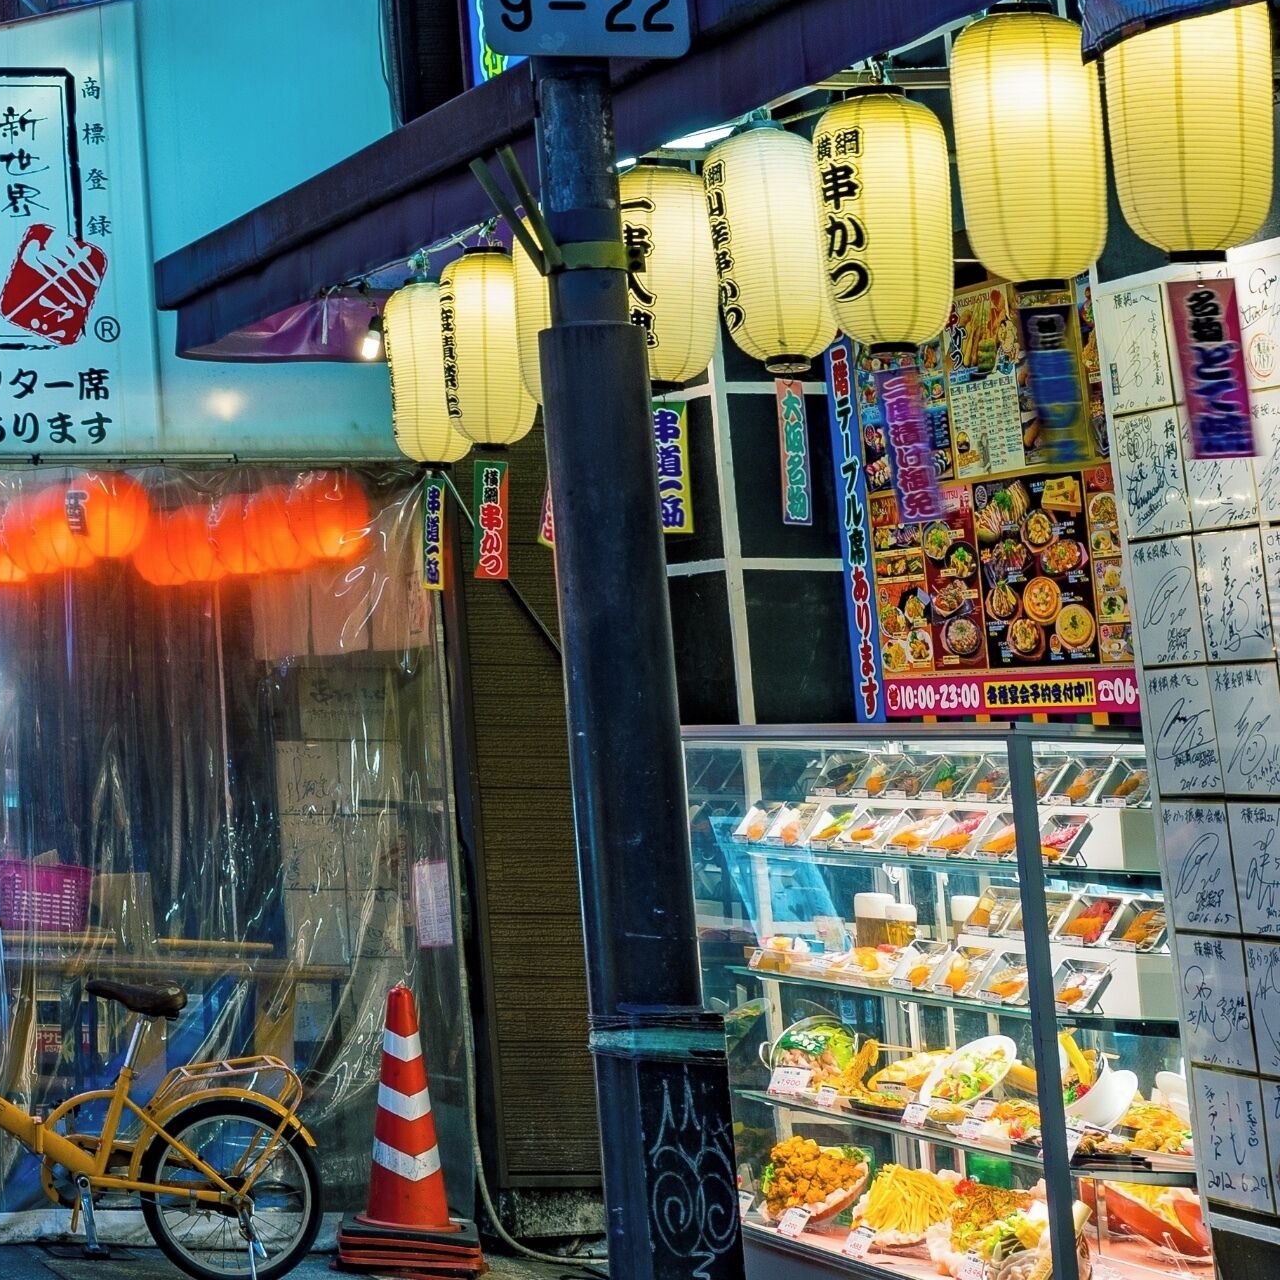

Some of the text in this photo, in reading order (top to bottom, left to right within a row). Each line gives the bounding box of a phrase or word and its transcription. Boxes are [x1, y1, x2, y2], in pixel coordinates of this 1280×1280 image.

[80, 75, 113, 239] 商標登録
[821, 164, 871, 301] 串かつ
[782, 392, 809, 523] 大阪名物
[900, 682, 980, 710] 10:00-23:00
